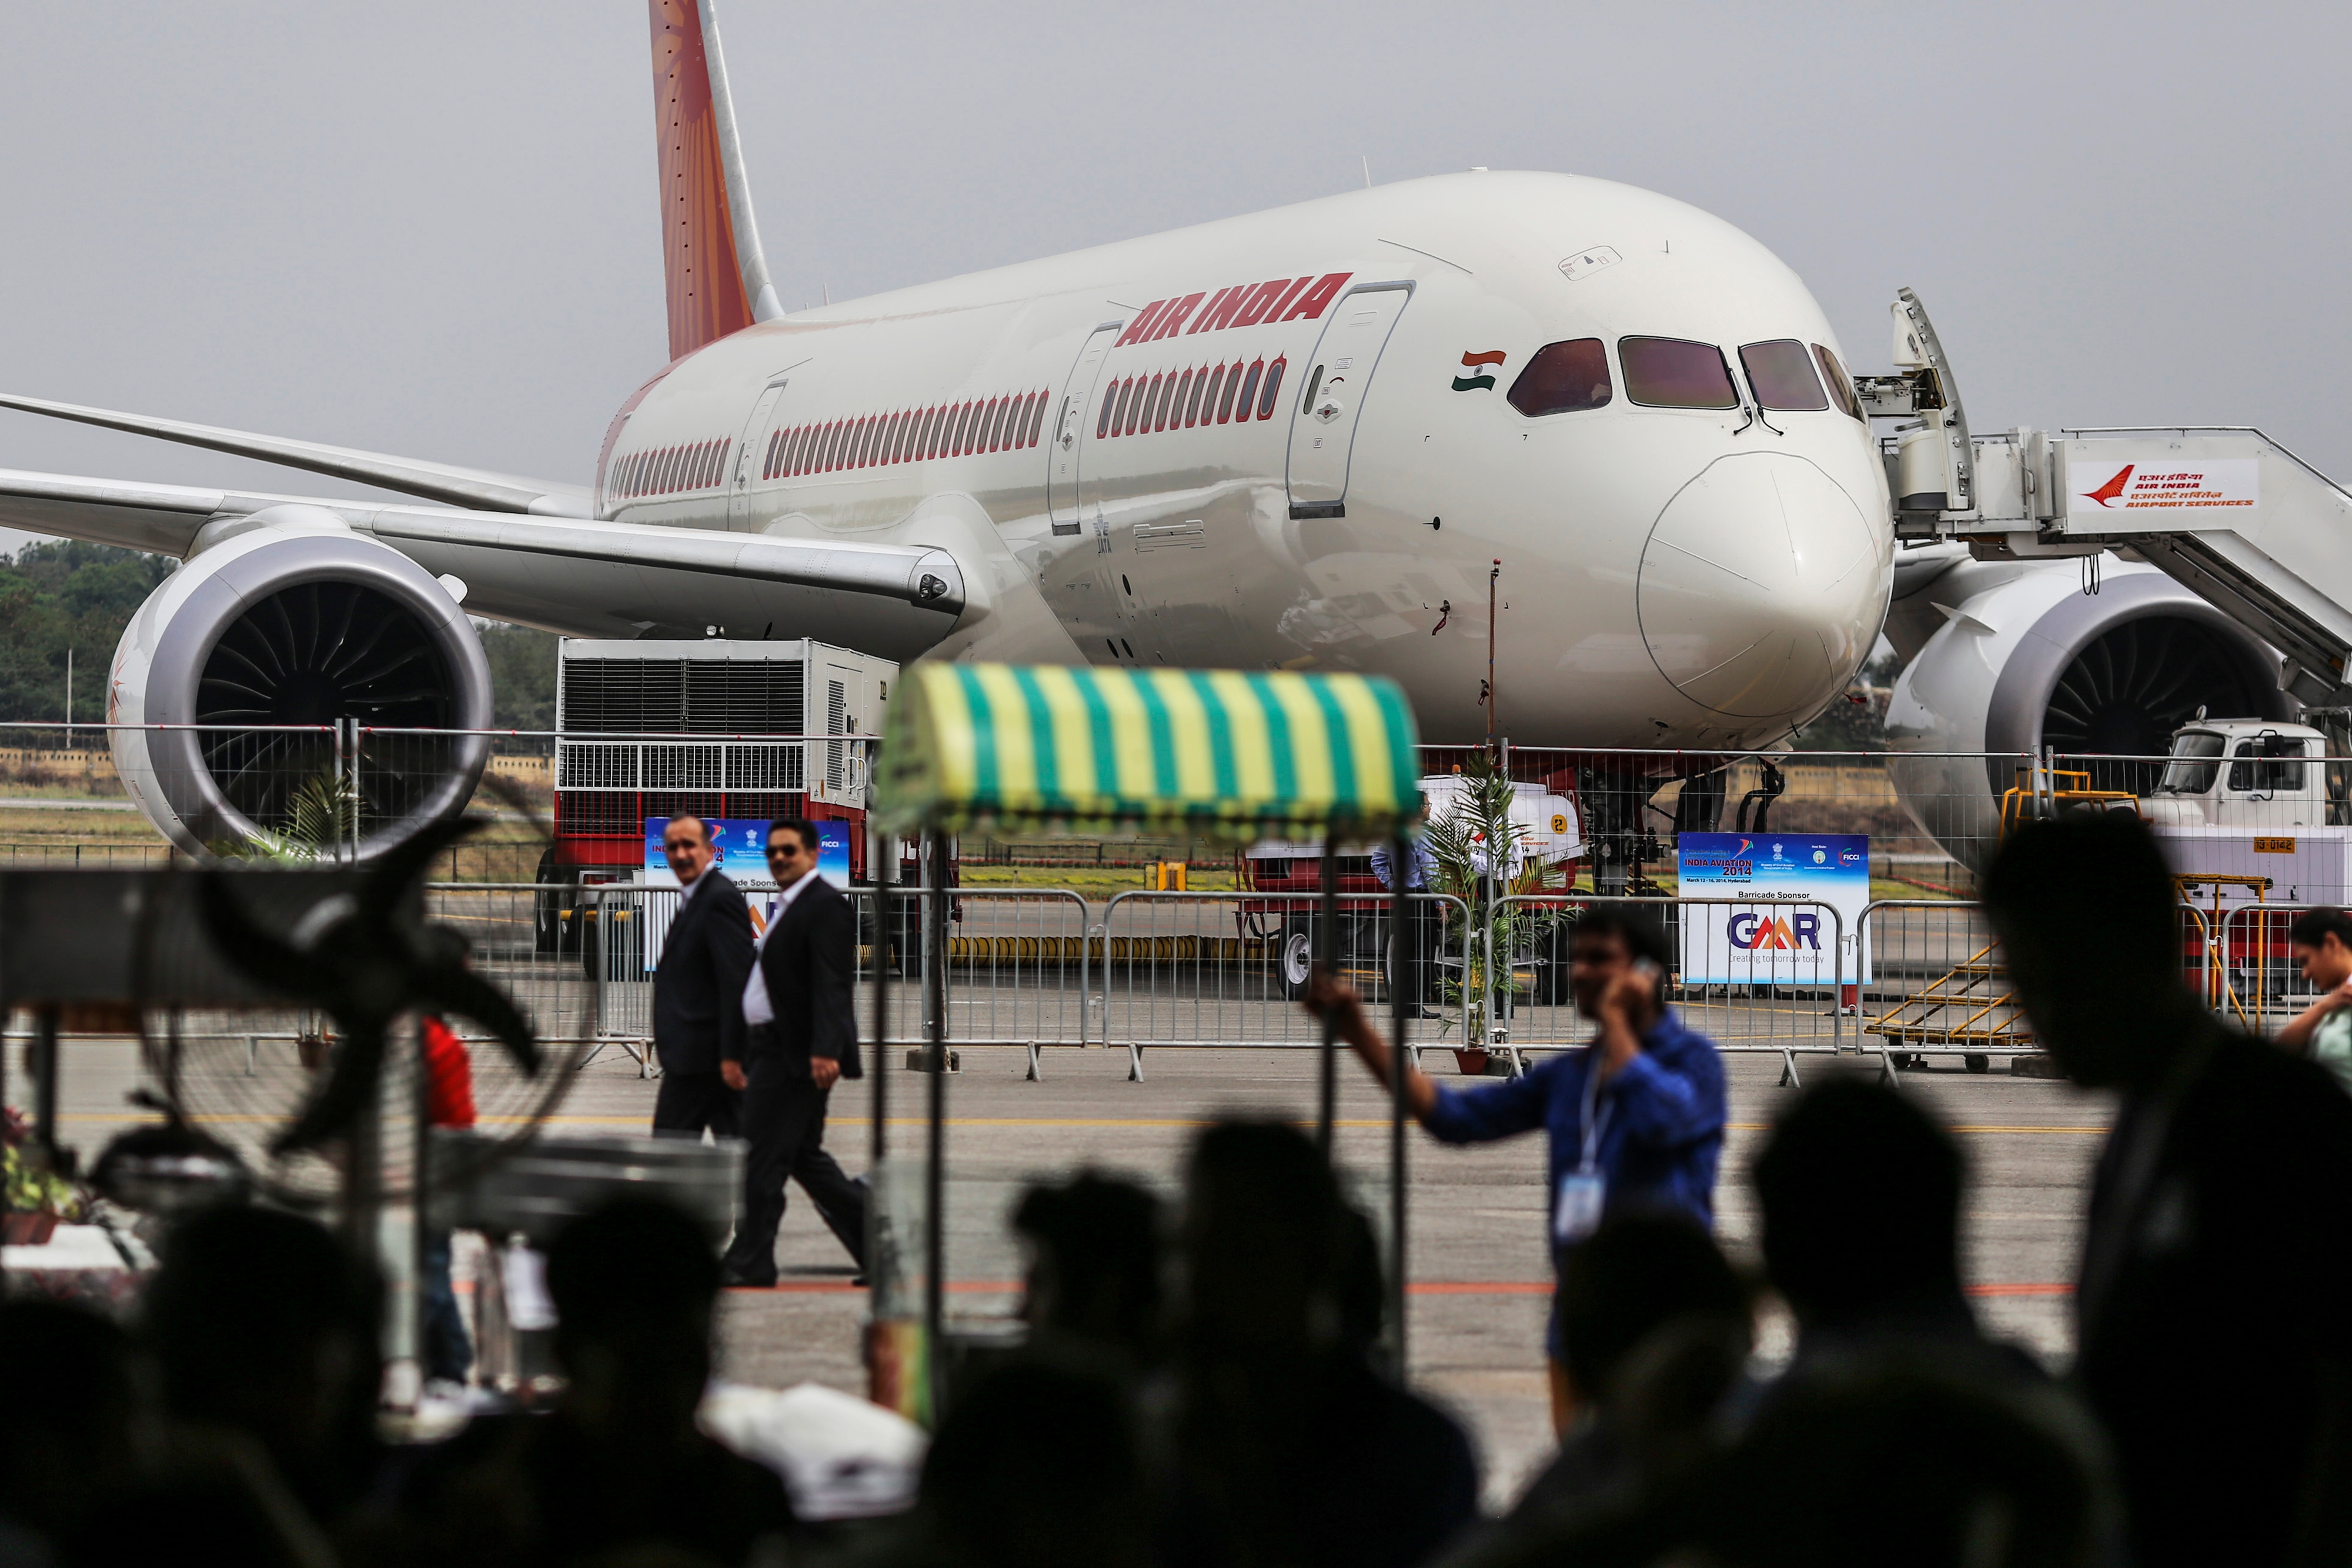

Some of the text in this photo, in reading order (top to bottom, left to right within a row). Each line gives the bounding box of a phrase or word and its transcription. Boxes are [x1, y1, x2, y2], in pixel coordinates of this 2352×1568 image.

[1114, 272, 1354, 347] AIR INDIA
[1555, 819, 1563, 831] 2
[1723, 867, 1752, 876] 2014
[1727, 913, 1822, 950] GMR
[1803, 955, 1824, 964] today
